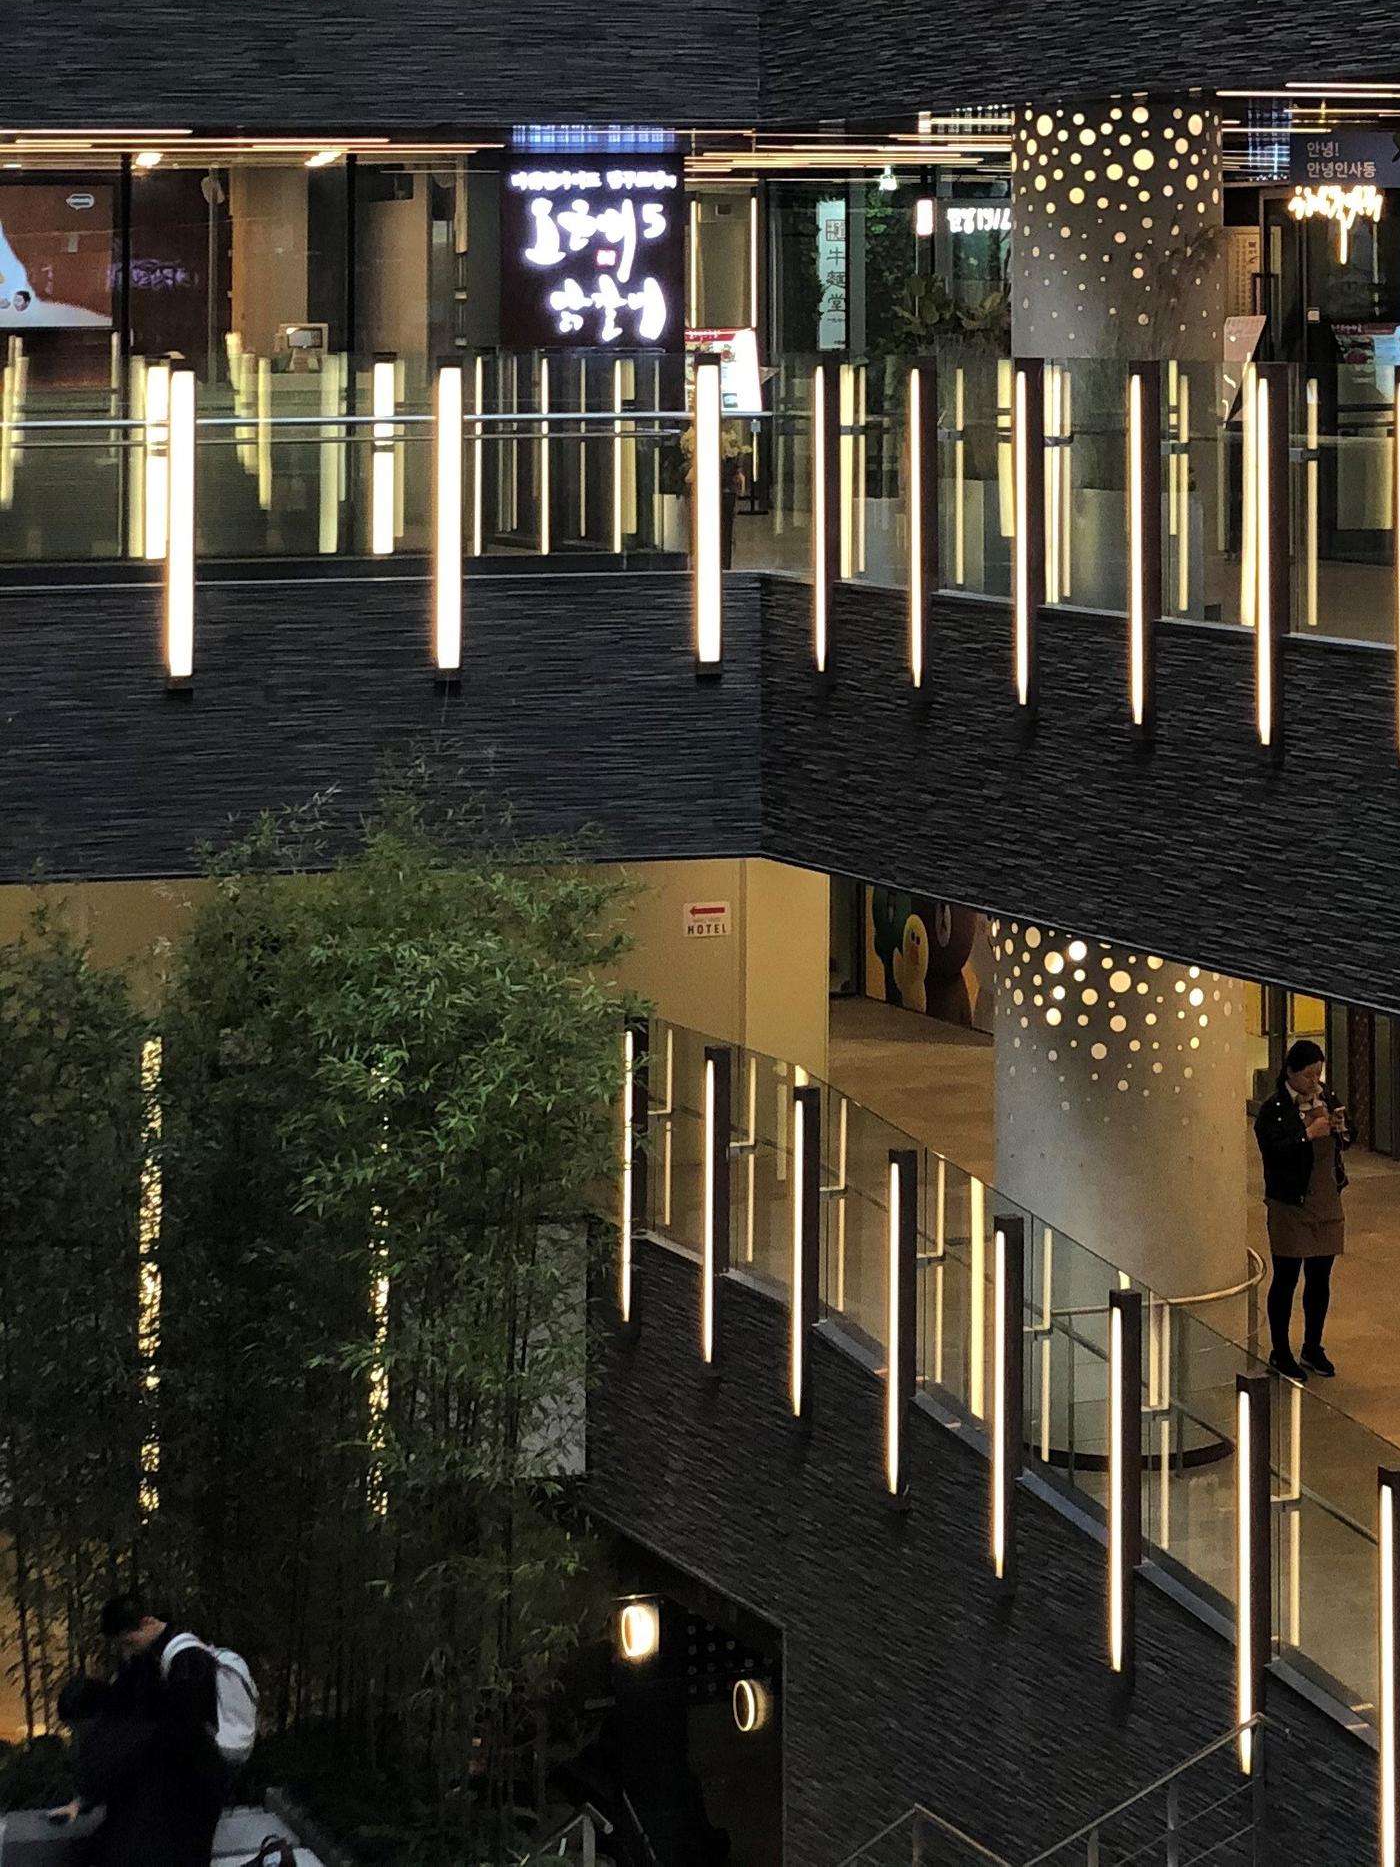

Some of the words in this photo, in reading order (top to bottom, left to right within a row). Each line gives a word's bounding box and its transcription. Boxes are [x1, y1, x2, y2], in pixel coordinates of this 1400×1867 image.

[1306, 141, 1340, 158] 안녕!
[1306, 161, 1377, 179] 안녕인사동
[687, 923, 726, 935] HOTEL
